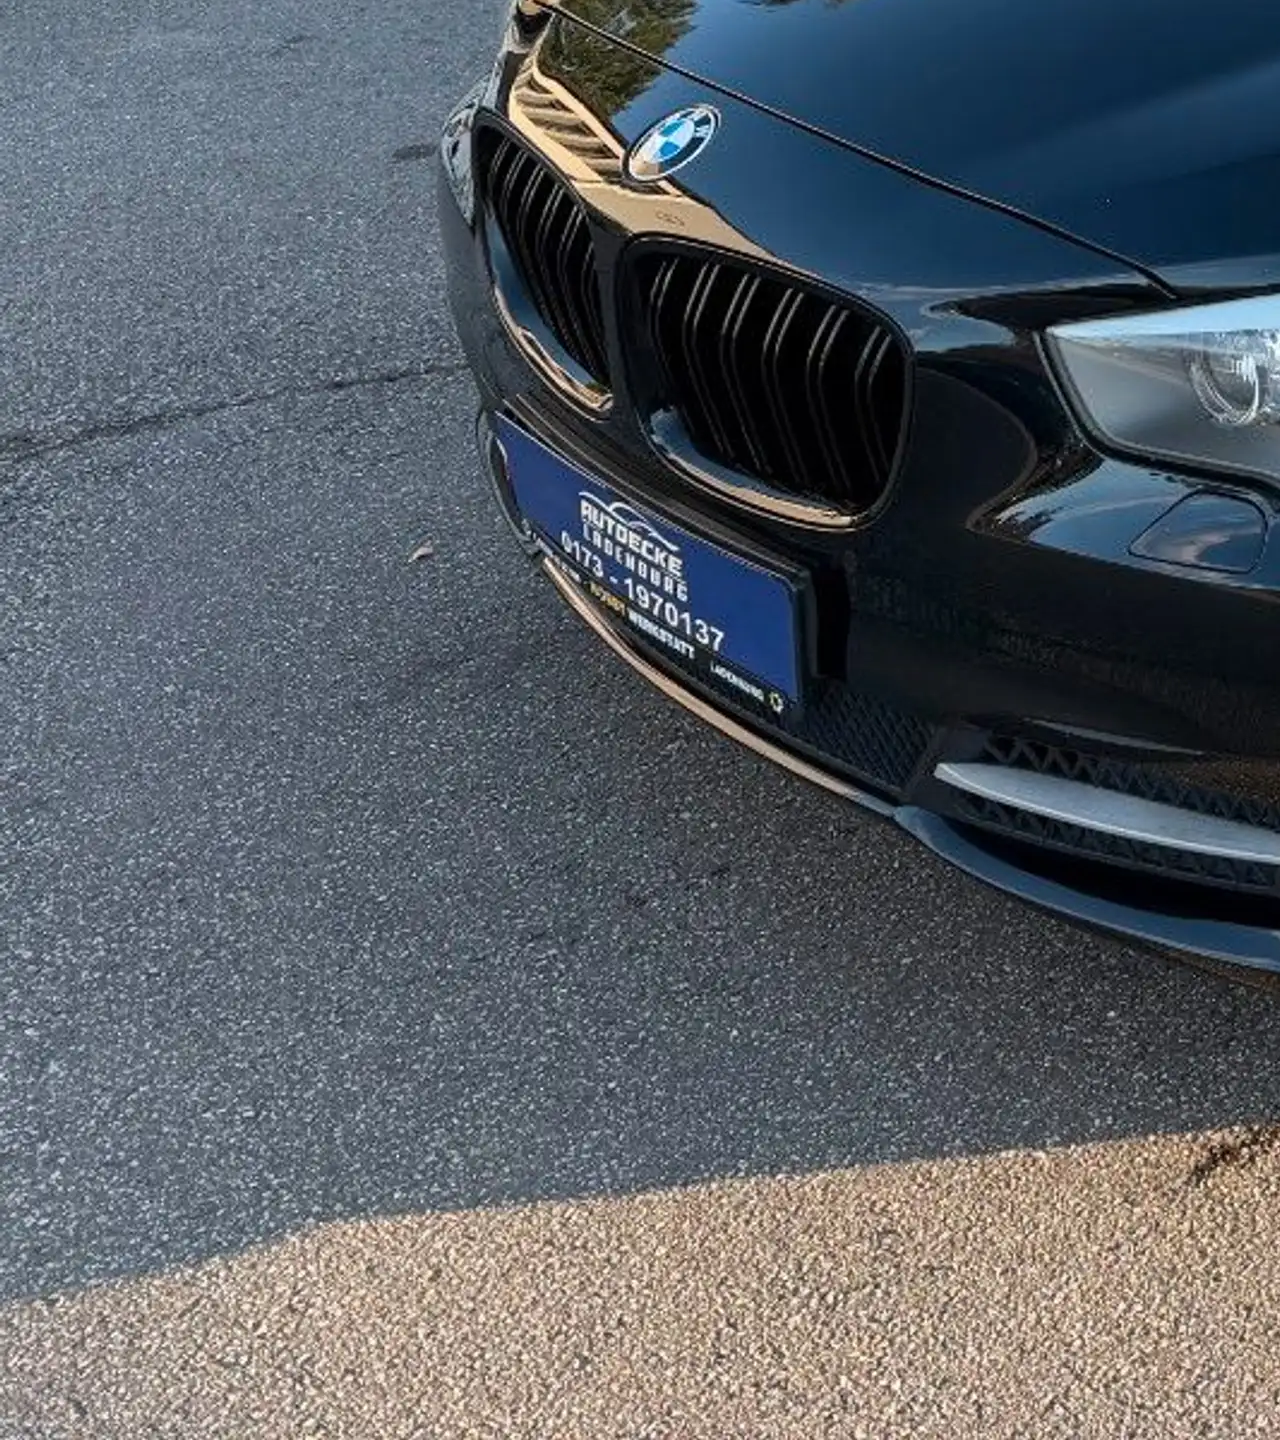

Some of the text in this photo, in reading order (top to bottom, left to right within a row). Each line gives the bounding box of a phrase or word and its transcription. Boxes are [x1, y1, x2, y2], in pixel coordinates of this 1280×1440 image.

[580, 498, 683, 578] AUTOECKE
[561, 529, 604, 577] 0173
[624, 577, 724, 651] 1970137
